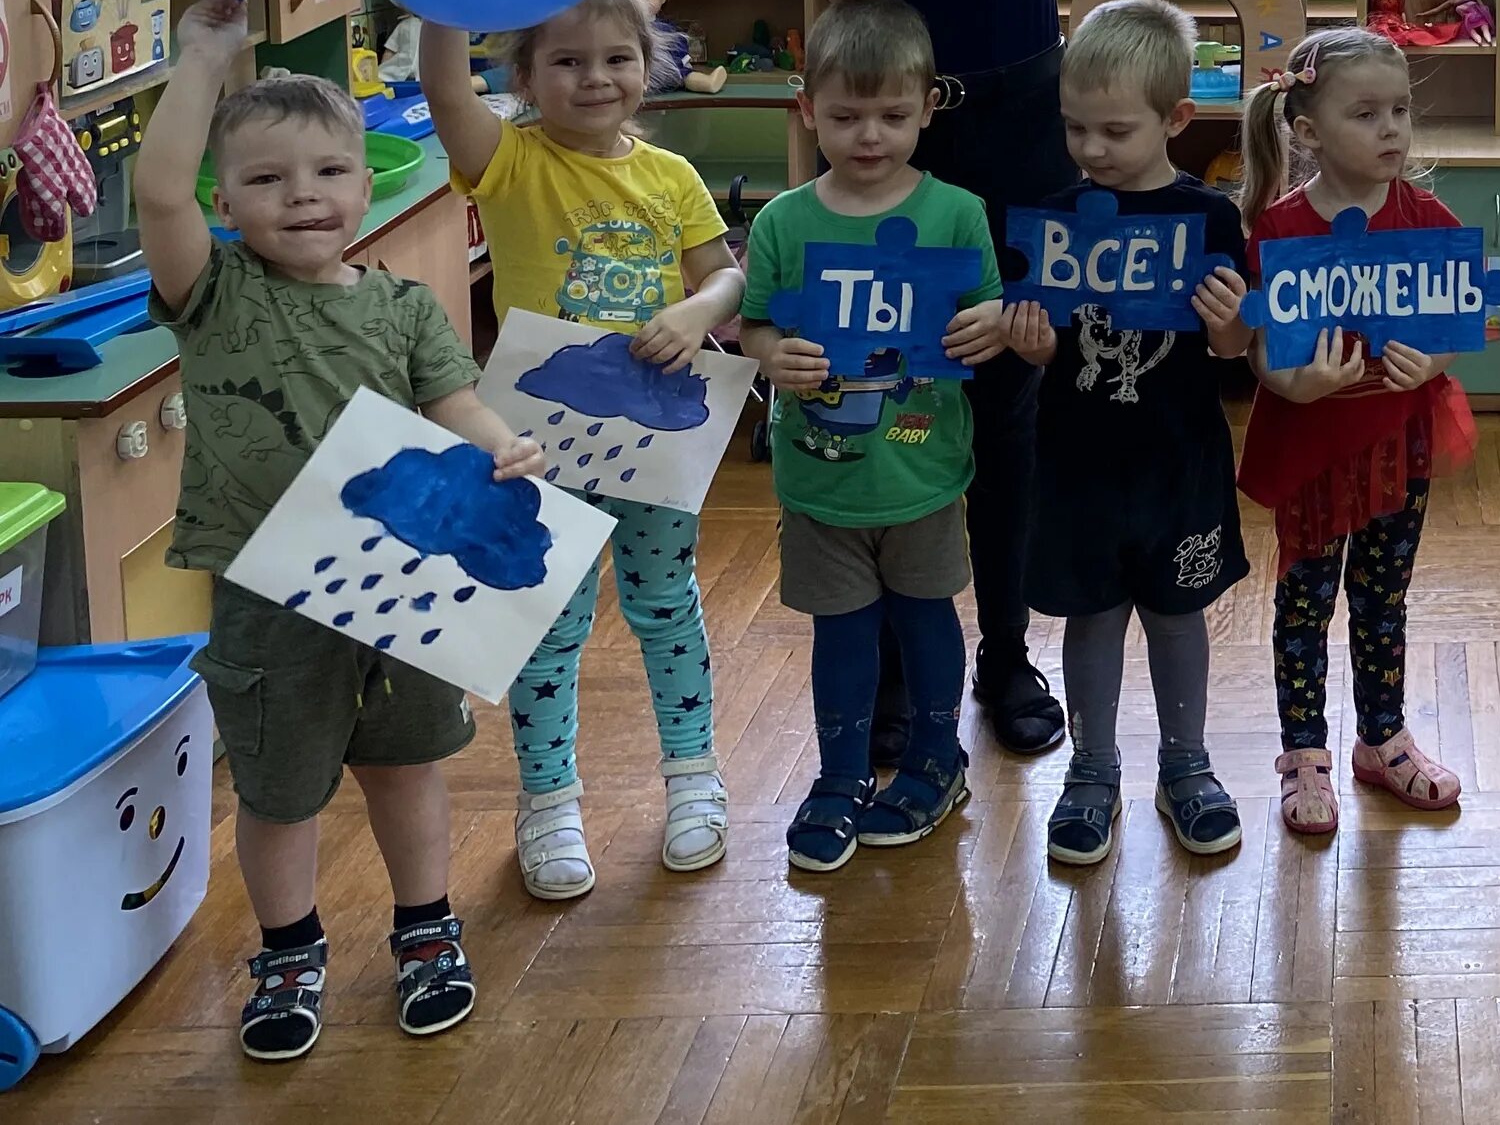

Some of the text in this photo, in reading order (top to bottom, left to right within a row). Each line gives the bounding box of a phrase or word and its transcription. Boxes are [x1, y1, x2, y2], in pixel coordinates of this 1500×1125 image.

[1268, 260, 1484, 324] СМОЖЕШЬ
[885, 426, 931, 444] BABY
[401, 926, 442, 941] antilopa
[267, 953, 309, 968] antilopa
